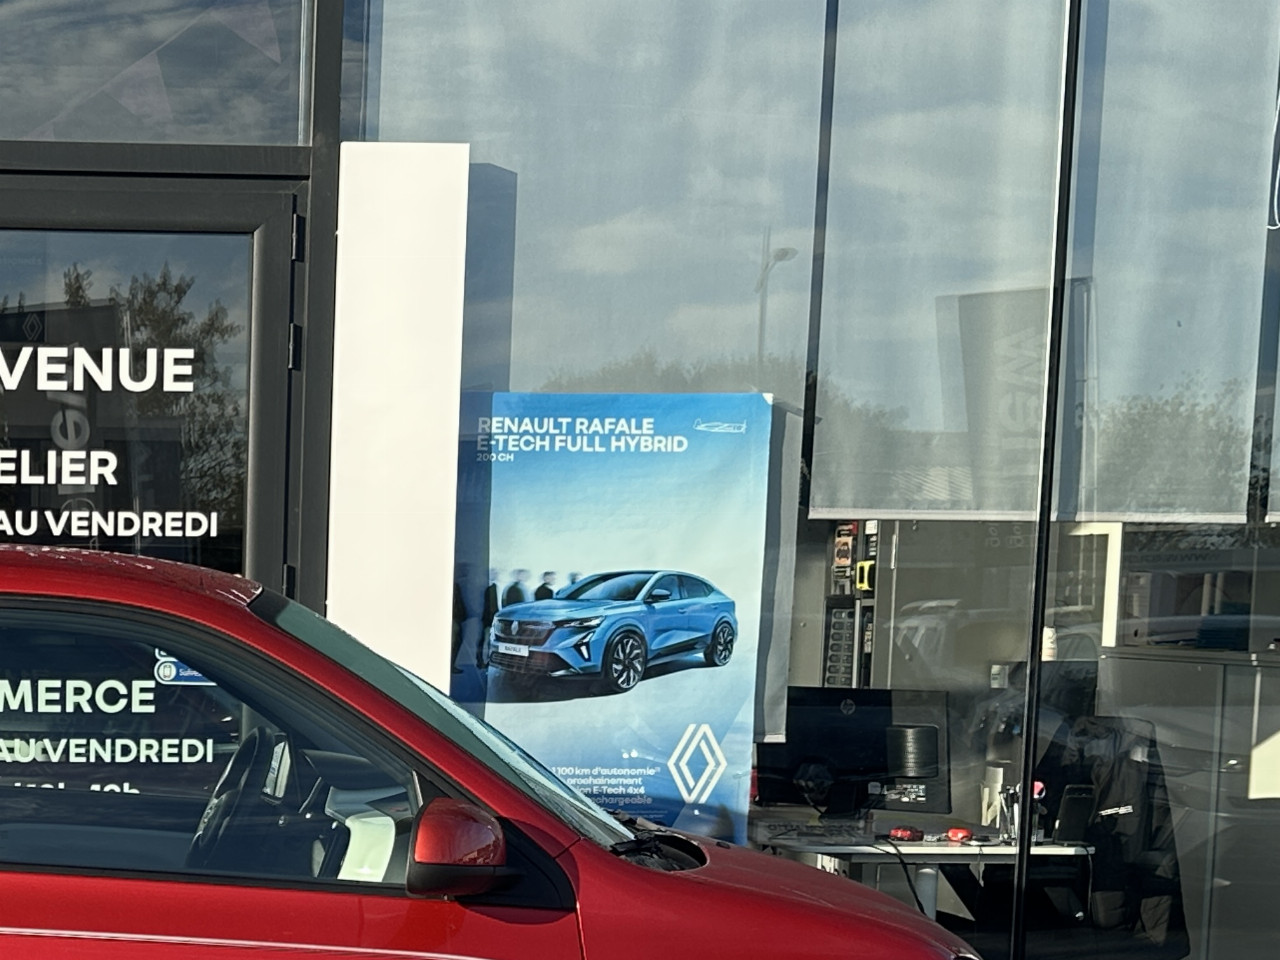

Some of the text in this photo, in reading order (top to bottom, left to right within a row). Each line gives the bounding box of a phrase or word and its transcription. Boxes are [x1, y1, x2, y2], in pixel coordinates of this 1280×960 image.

[477, 416, 655, 436] RENAULT RAFALE
[476, 434, 689, 453] E-TECH FULL HYBRID
[497, 453, 514, 462] CH
[44, 510, 219, 539] VENDREDI
[42, 738, 214, 764] VENDREDI
